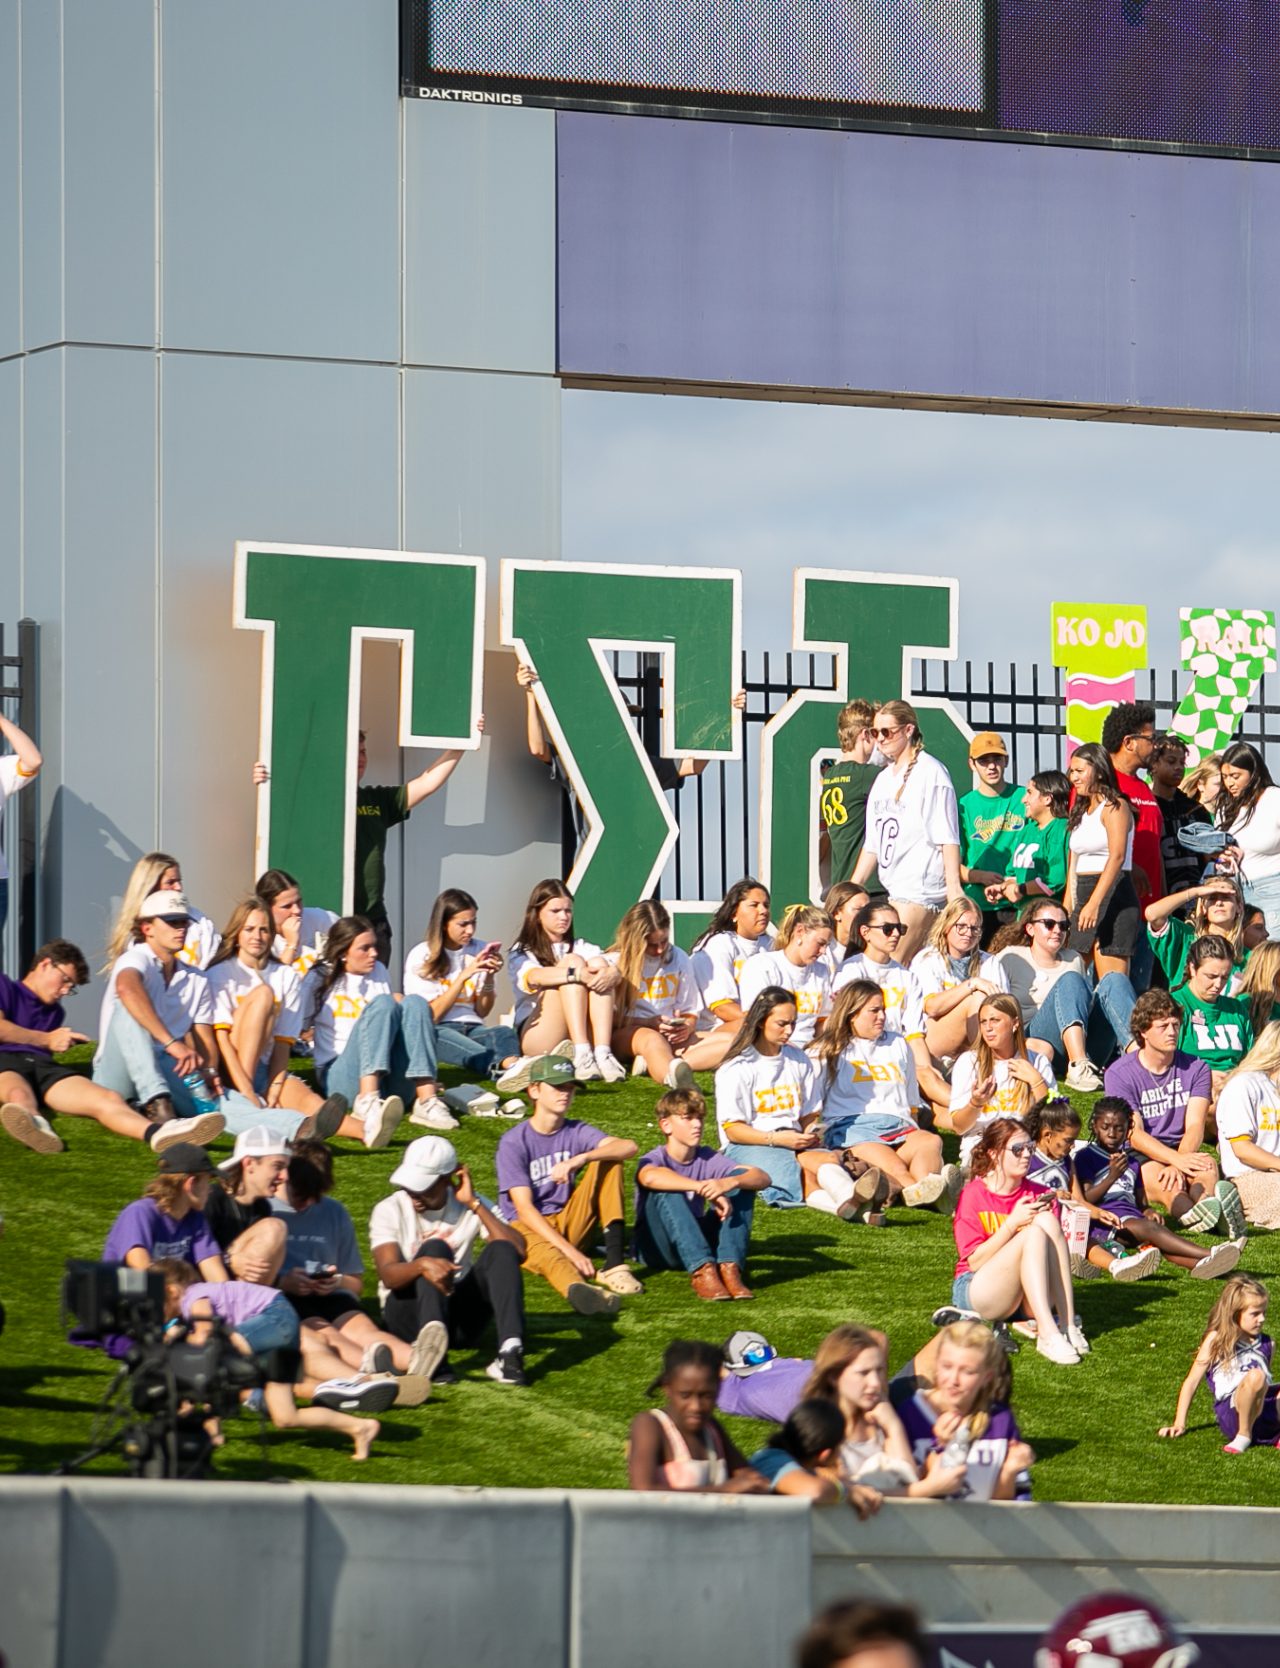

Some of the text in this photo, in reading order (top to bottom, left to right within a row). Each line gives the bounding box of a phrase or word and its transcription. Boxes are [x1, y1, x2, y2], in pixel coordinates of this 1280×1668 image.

[419, 87, 523, 105] DAKTRONICS
[1057, 617, 1145, 648] KO JO
[822, 787, 848, 827] 68
